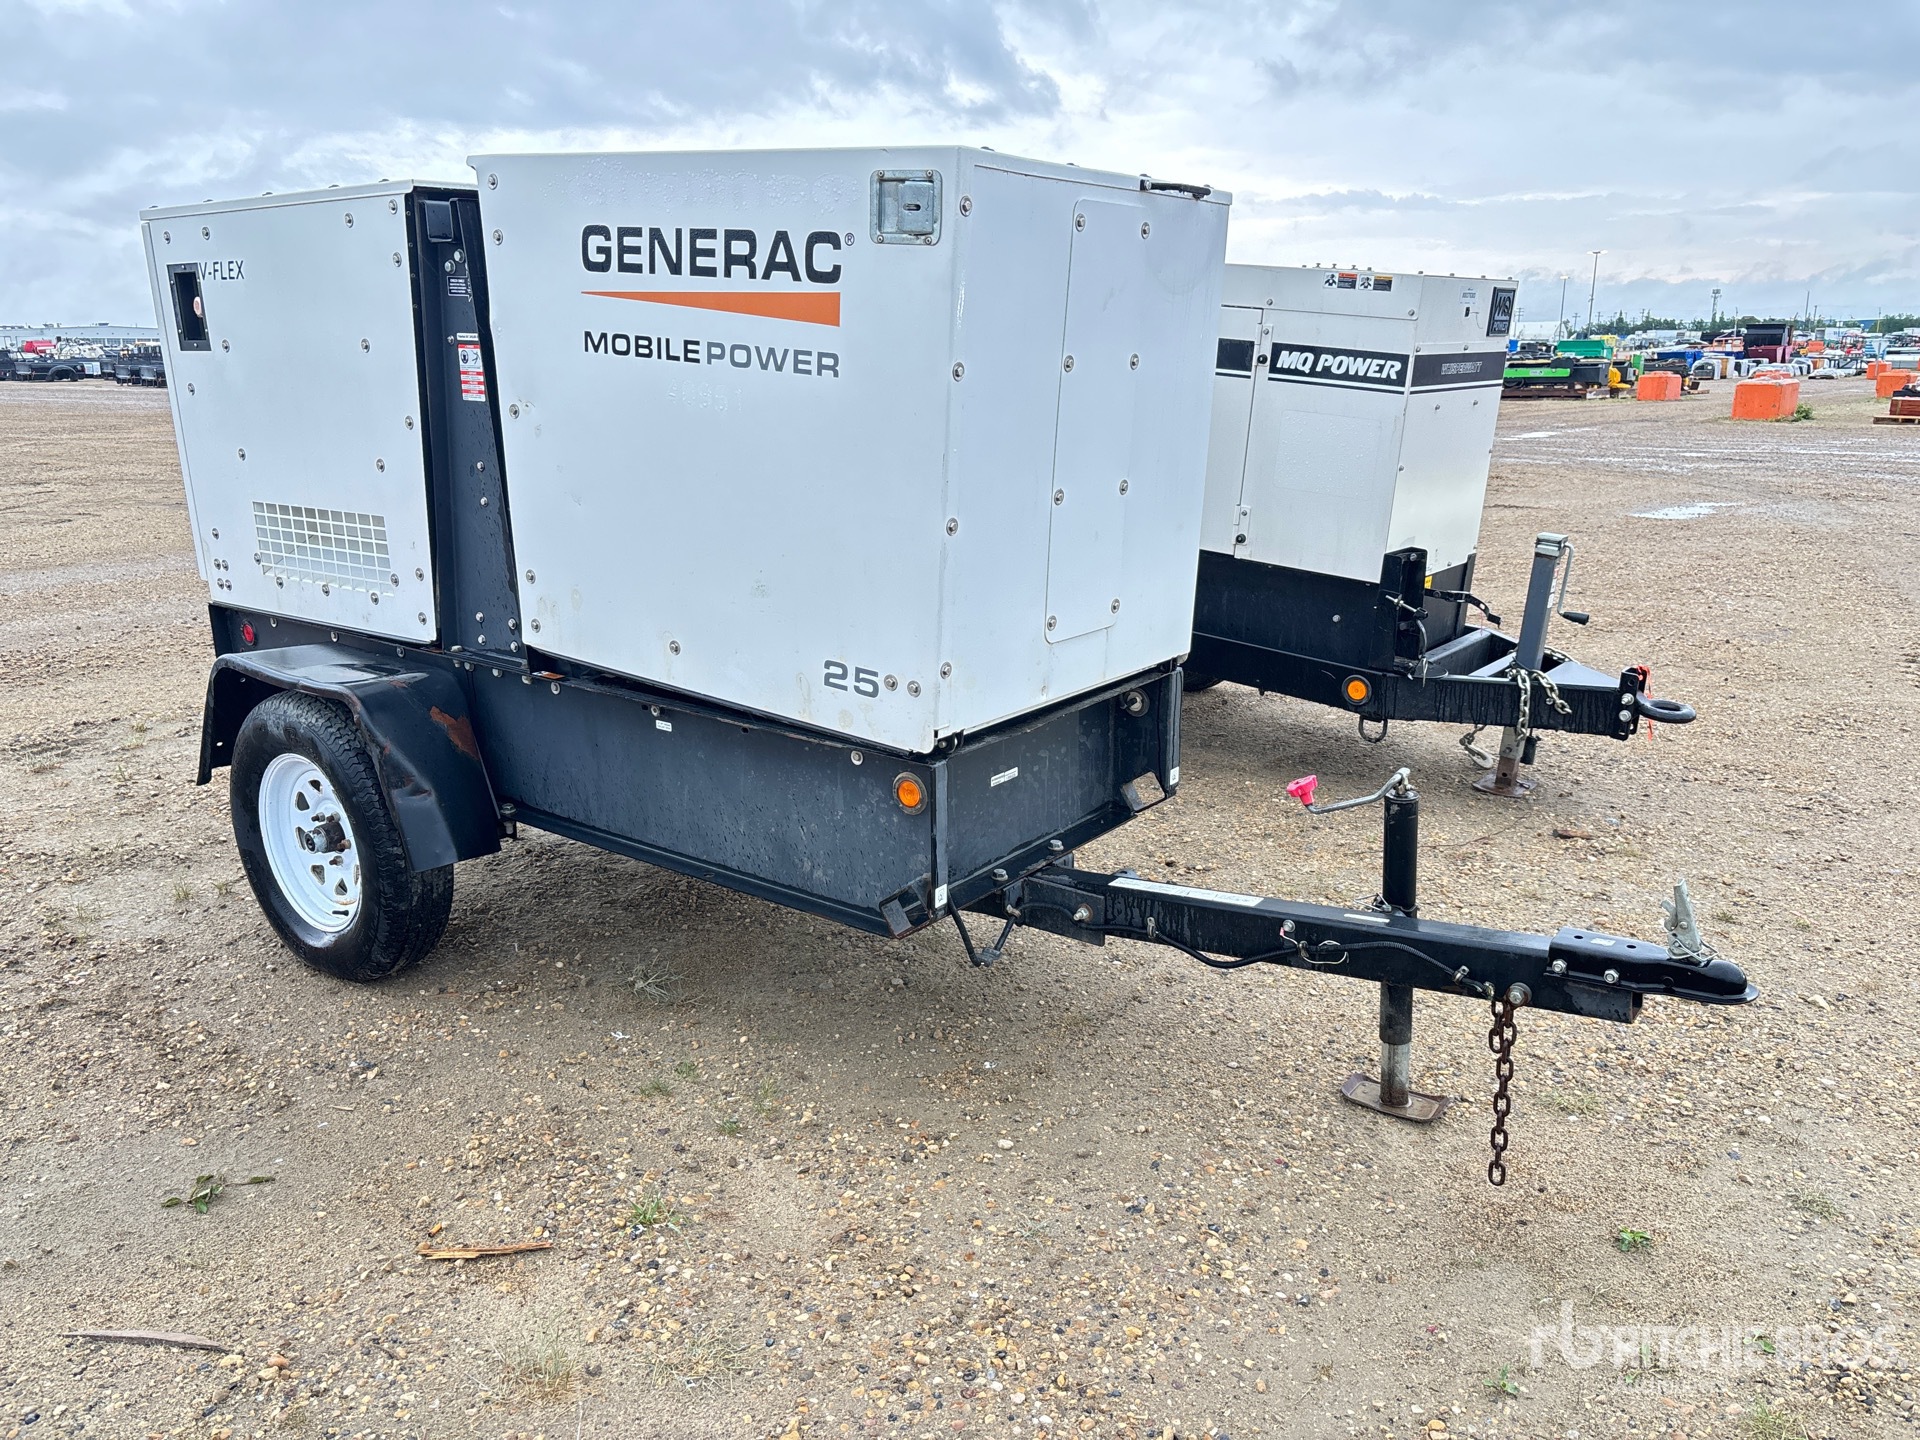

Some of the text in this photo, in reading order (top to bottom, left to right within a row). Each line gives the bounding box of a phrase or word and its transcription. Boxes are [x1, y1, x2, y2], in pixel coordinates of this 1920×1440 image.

[199, 260, 245, 281] V-FLEX
[1277, 350, 1402, 380] MQ POWER
[824, 660, 880, 699] 25
